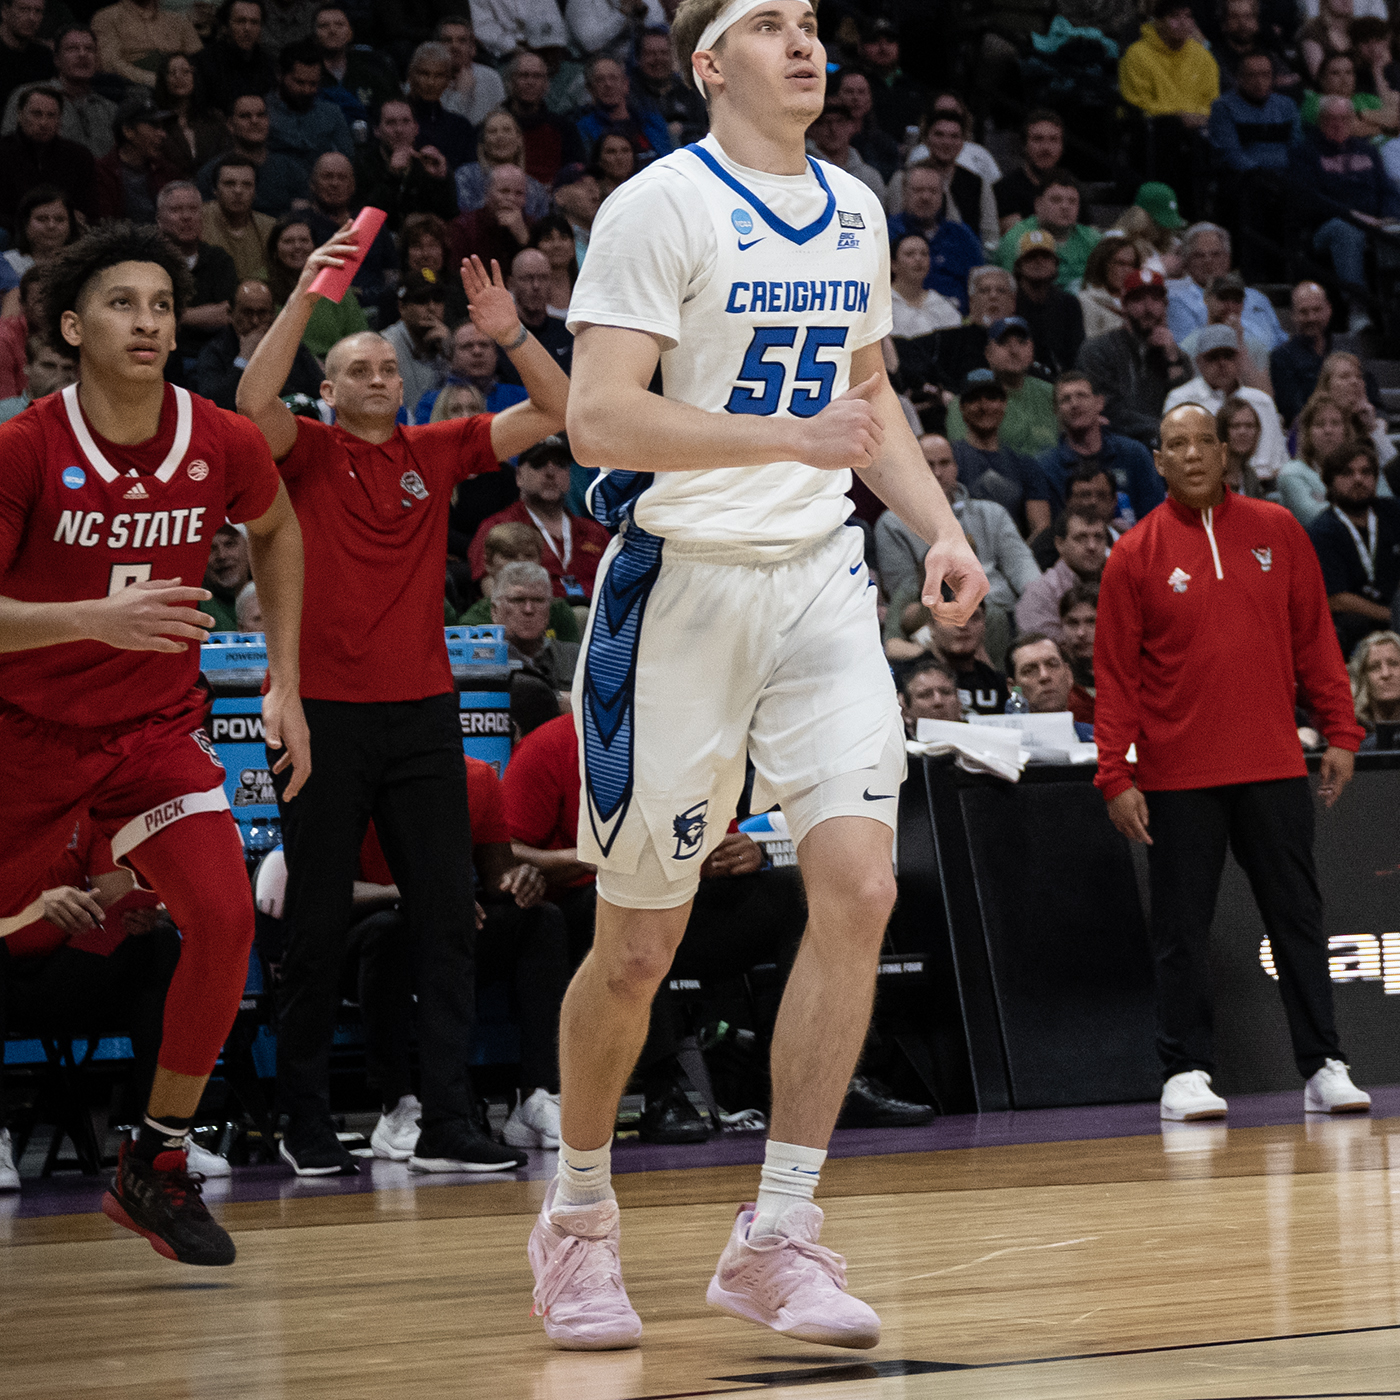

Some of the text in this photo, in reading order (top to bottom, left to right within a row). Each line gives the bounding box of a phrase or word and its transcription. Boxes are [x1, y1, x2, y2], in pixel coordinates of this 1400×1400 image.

[725, 280, 870, 314] CREIGHTON
[723, 326, 850, 419] 55
[53, 506, 207, 549] NC STATE
[144, 798, 185, 833] PACK
